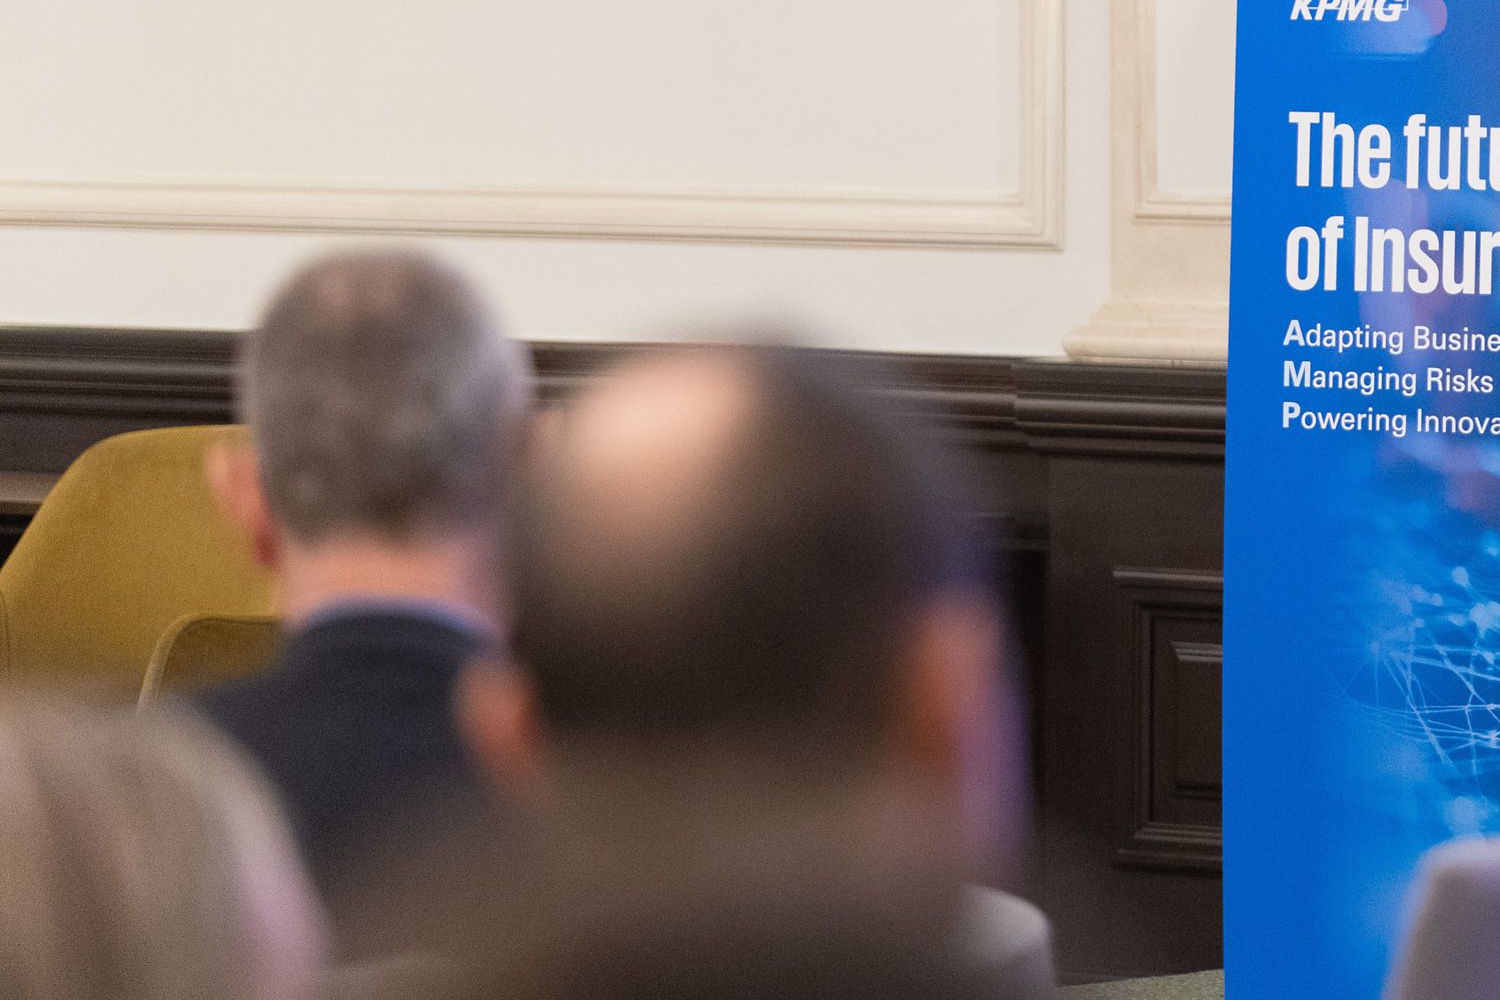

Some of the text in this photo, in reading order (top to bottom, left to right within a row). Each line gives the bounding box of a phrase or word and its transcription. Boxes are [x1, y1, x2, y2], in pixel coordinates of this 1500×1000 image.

[1289, 111, 1391, 188] The
[1286, 216, 1344, 291] of
[1283, 320, 1404, 355] Adapting
[1283, 361, 1417, 396] Managing
[1427, 367, 1494, 393] Risks
[1282, 402, 1407, 438] Powering
